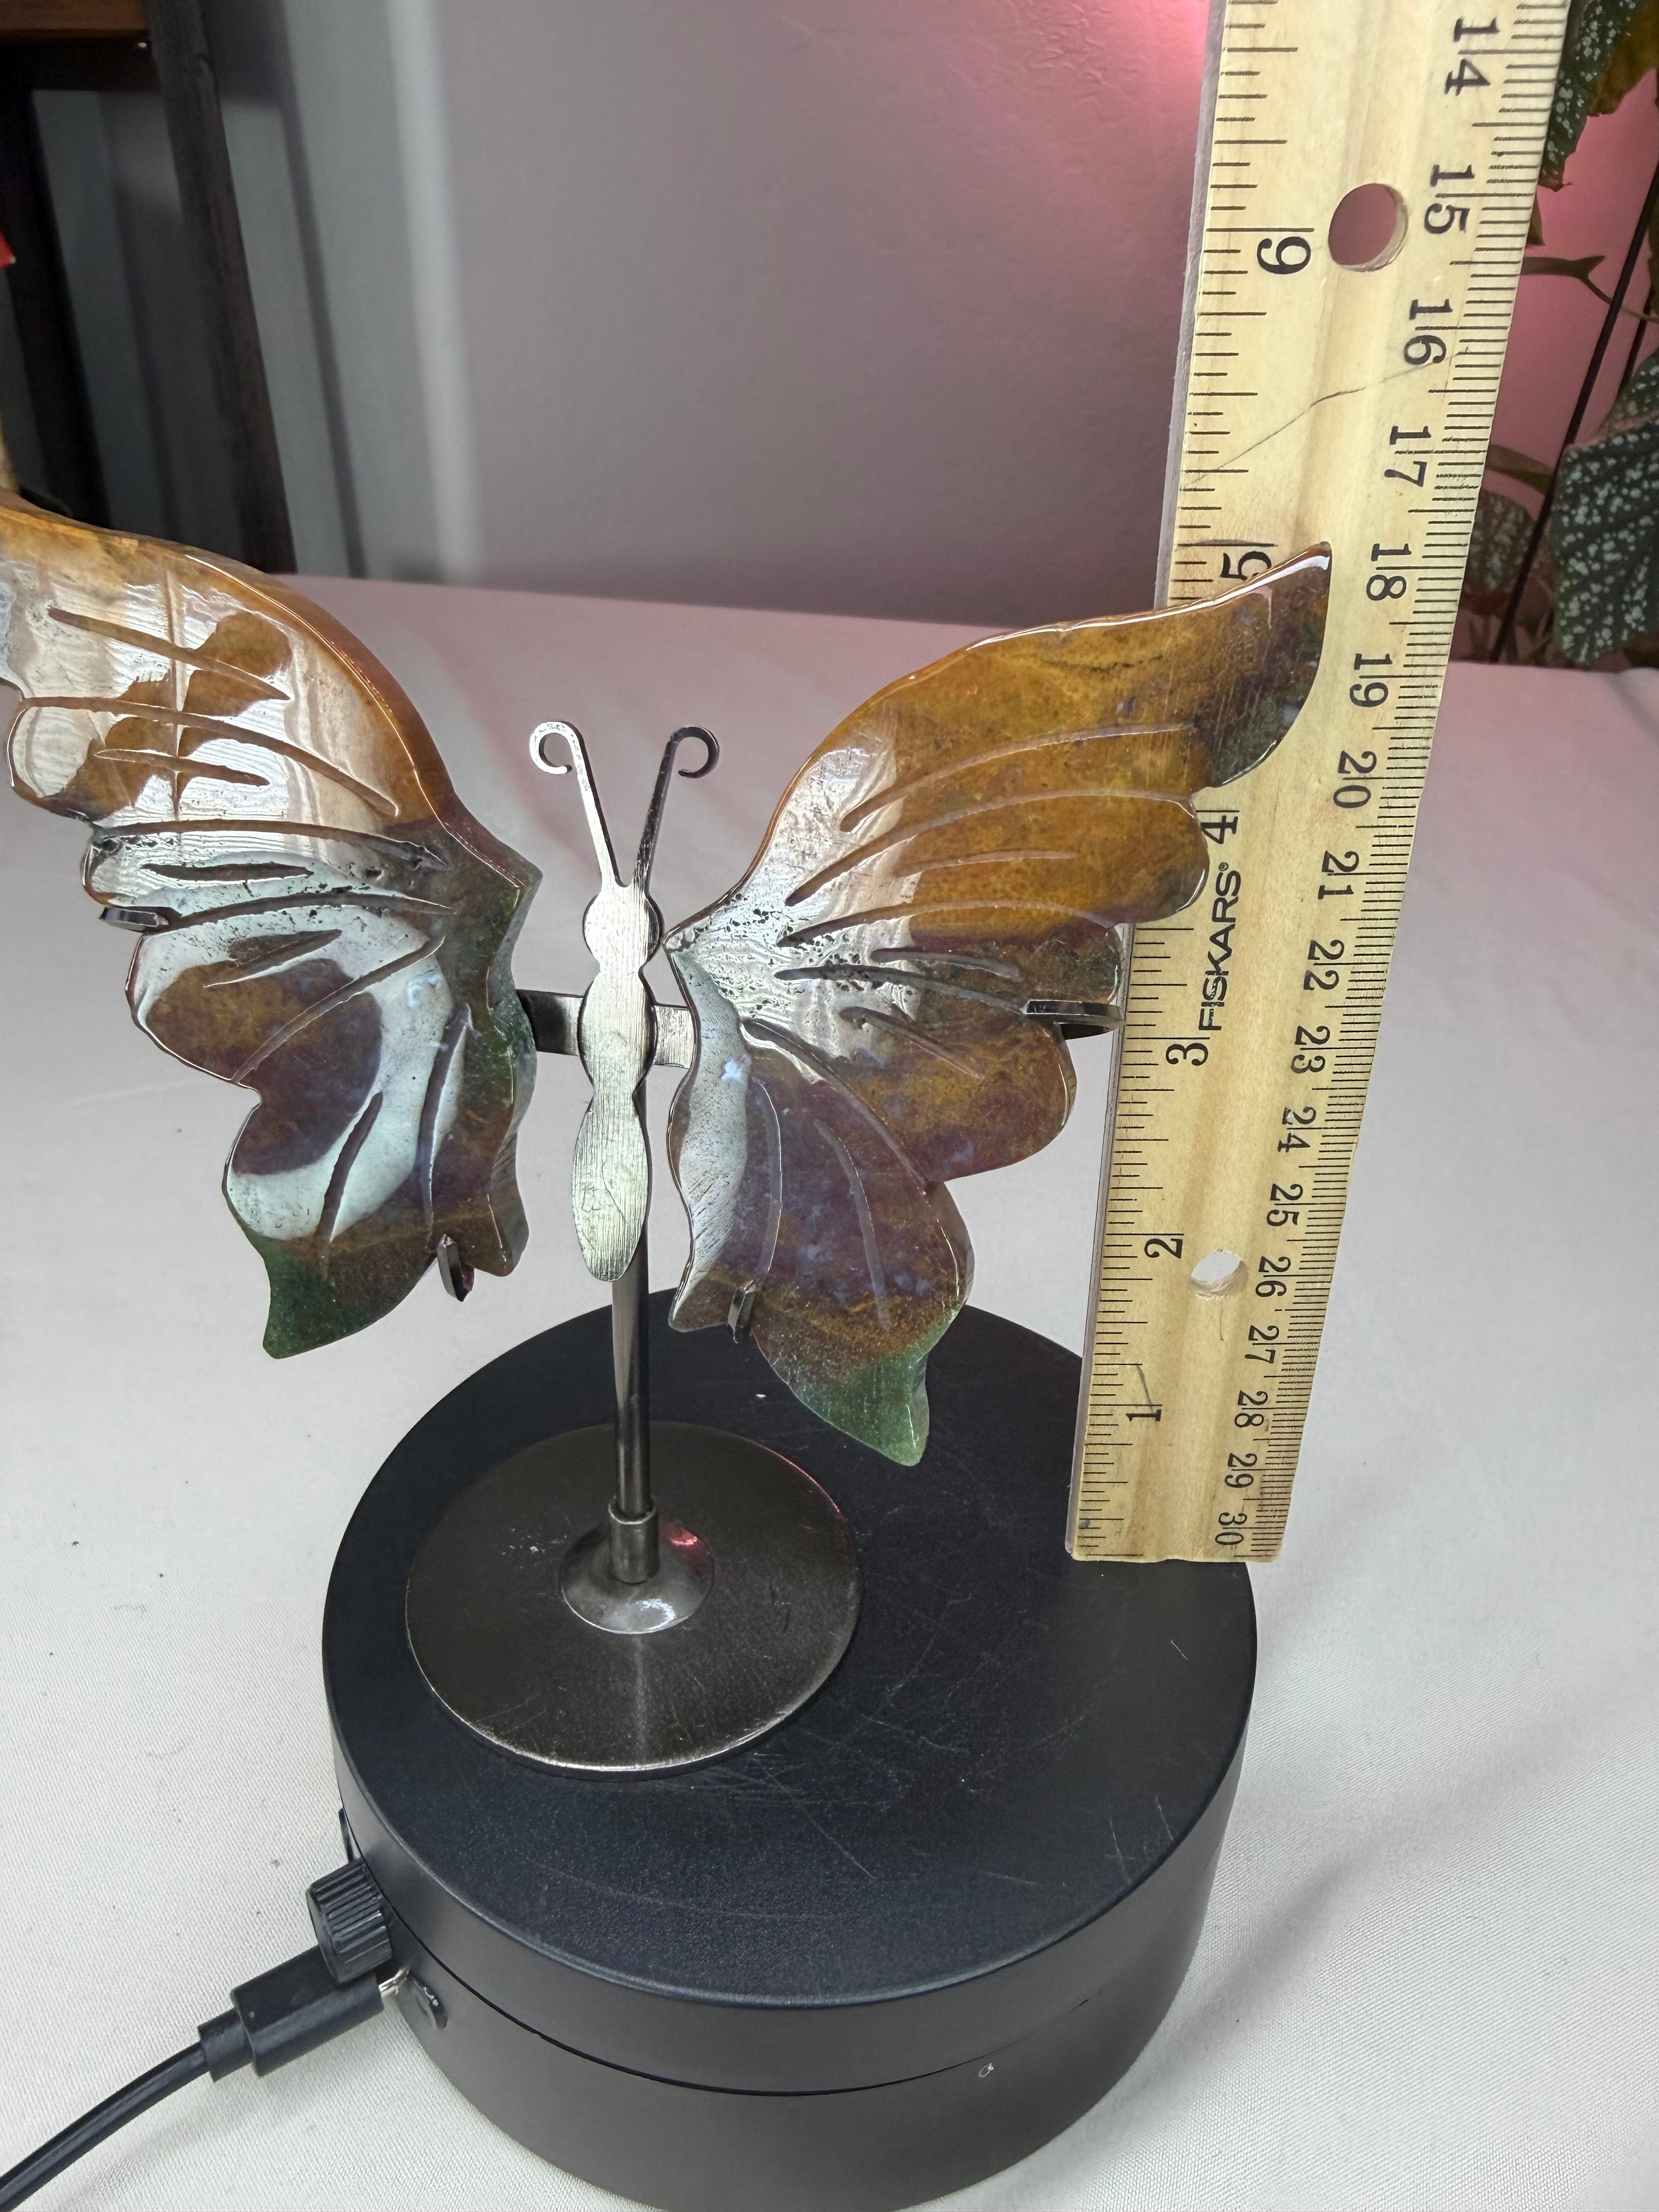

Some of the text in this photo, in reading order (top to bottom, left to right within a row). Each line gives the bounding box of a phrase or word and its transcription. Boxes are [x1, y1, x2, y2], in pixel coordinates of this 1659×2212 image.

[1445, 17, 1499, 95] 14
[1424, 165, 1475, 234] 15
[1257, 236, 1312, 274] 6
[1404, 299, 1453, 365] 16
[1384, 426, 1432, 487] 17
[1220, 550, 1272, 581] 5
[1366, 543, 1412, 601] 18
[1349, 653, 1393, 707] 19
[1333, 750, 1377, 808] 20
[1201, 815, 1238, 844] 4
[1318, 850, 1360, 900] 21
[1303, 940, 1345, 990] 22
[1165, 1042, 1209, 1066] 3
[1291, 1025, 1331, 1074] 23
[1278, 1107, 1317, 1152] 24
[1266, 1183, 1304, 1227] 25
[1144, 1238, 1183, 1259] 2
[1255, 1256, 1291, 1297] 26
[1245, 1325, 1280, 1364] 27
[1126, 1409, 1162, 1422] 1
[1234, 1391, 1268, 1428] 28
[1224, 1453, 1258, 1488] 29
[1215, 1512, 1248, 1546] 30
